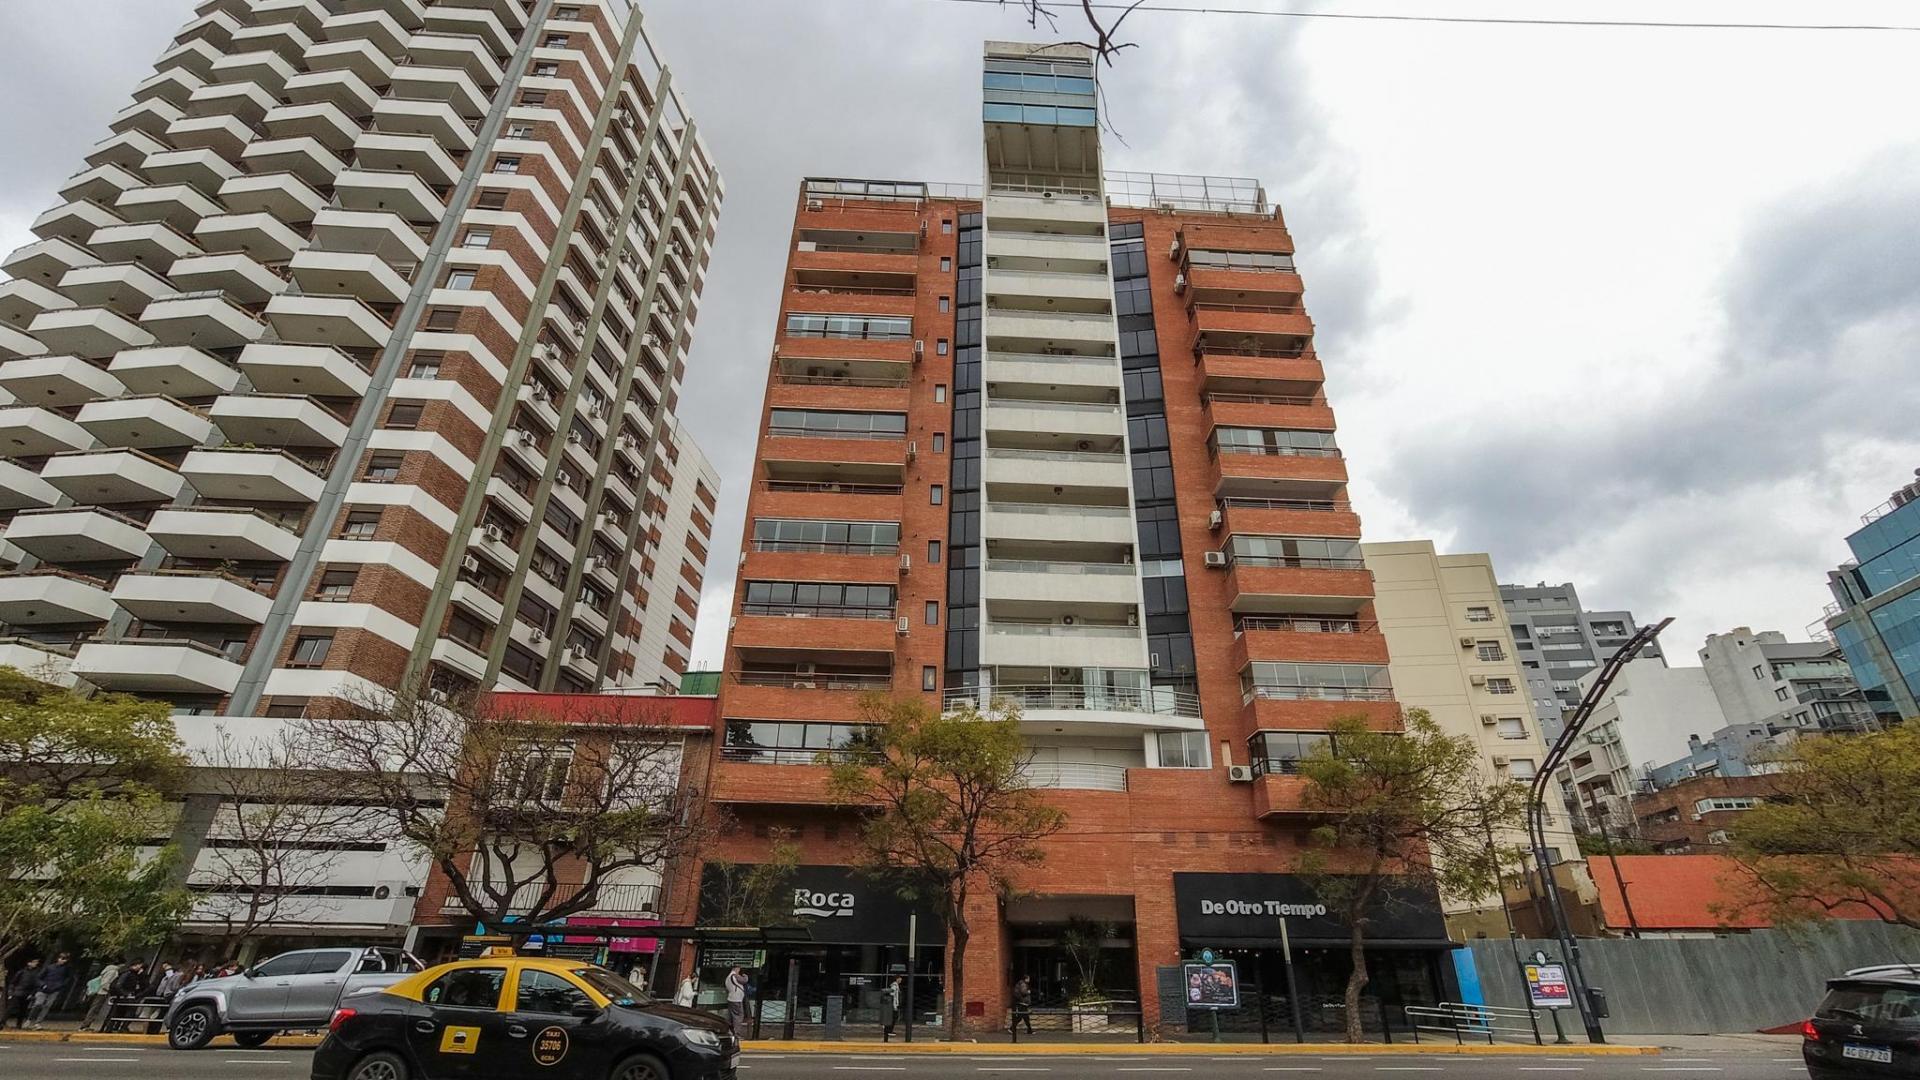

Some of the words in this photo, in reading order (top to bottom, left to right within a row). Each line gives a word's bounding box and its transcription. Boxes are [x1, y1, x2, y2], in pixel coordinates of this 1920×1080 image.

[794, 888, 855, 908] Roca
[1201, 899, 1225, 915] De
[1225, 899, 1263, 915] Otro
[1263, 900, 1327, 919] Tiempo
